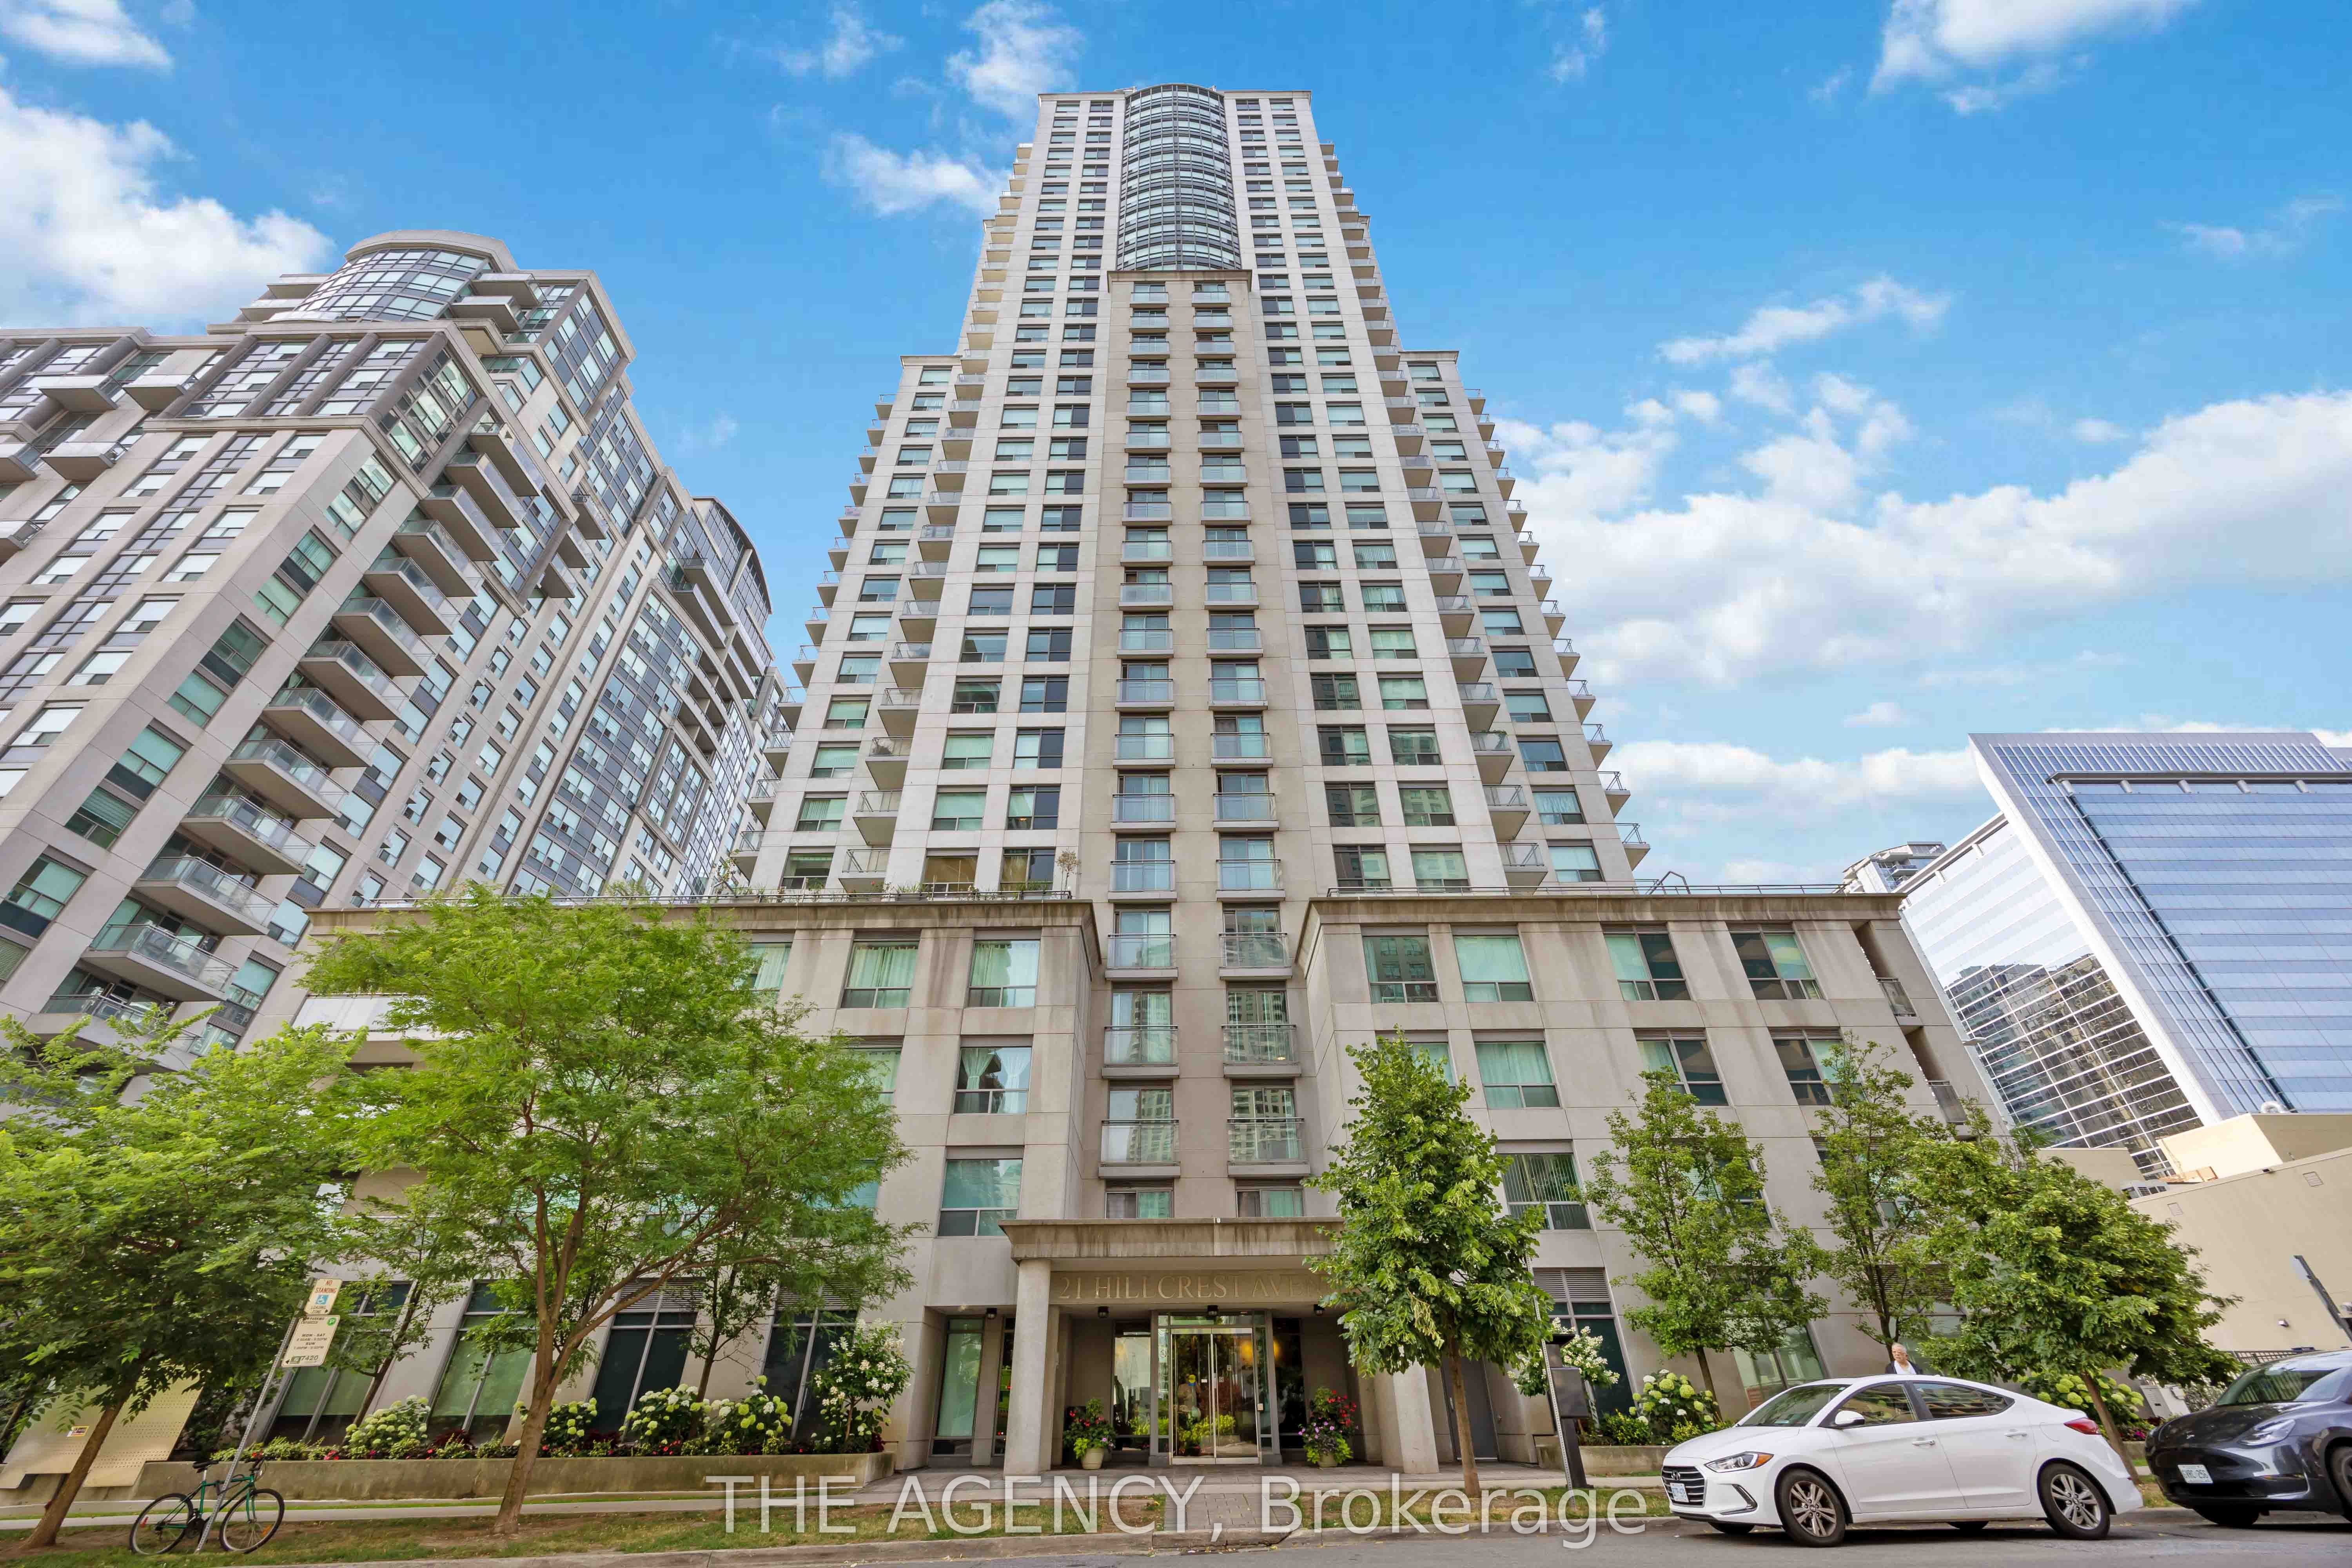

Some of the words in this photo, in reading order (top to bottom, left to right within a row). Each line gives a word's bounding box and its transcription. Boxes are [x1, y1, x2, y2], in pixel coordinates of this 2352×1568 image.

[1058, 1276, 1082, 1299] 21
[1094, 1276, 1241, 1299] HILLCREST
[1251, 1275, 1330, 1298] AVEN
